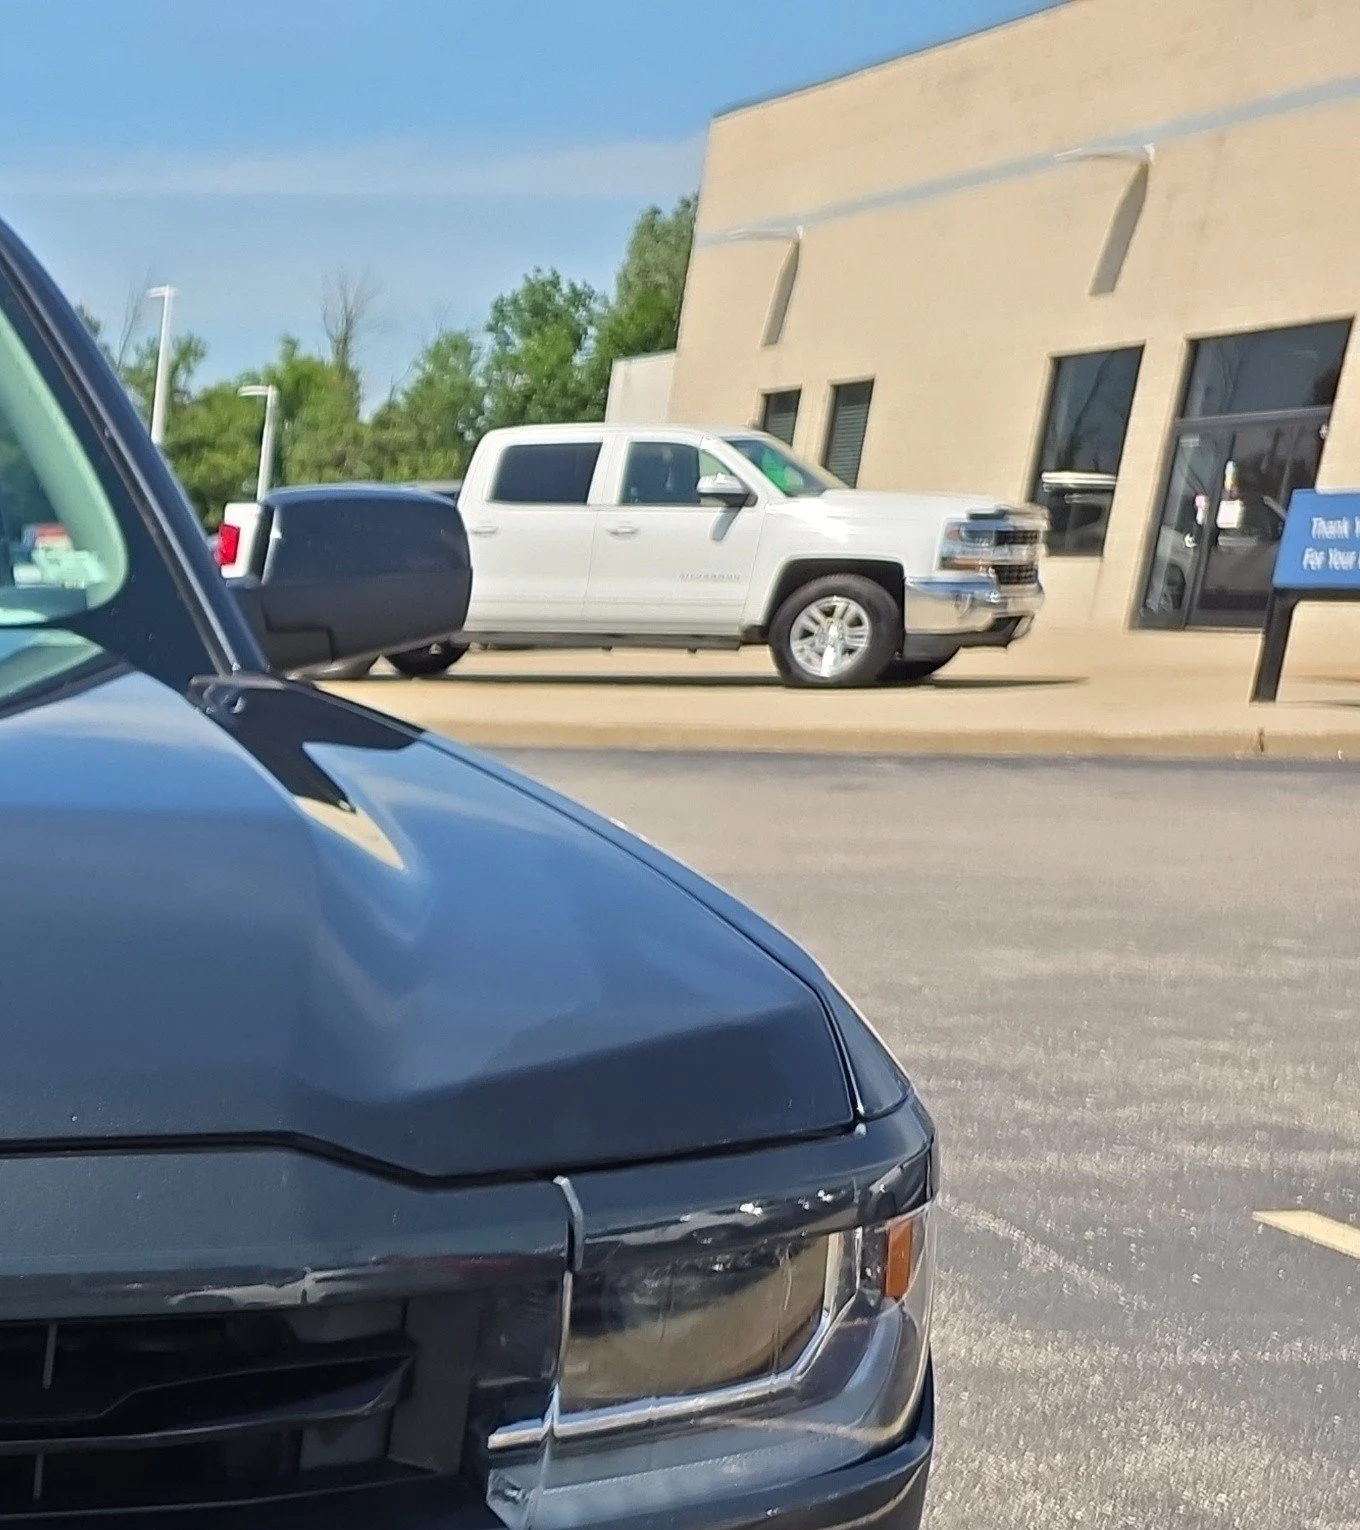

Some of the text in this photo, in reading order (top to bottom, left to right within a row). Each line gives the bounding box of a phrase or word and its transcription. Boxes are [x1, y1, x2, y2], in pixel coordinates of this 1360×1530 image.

[1311, 516, 1349, 539] Thank
[1302, 547, 1325, 570] For
[1328, 547, 1357, 570] Your
